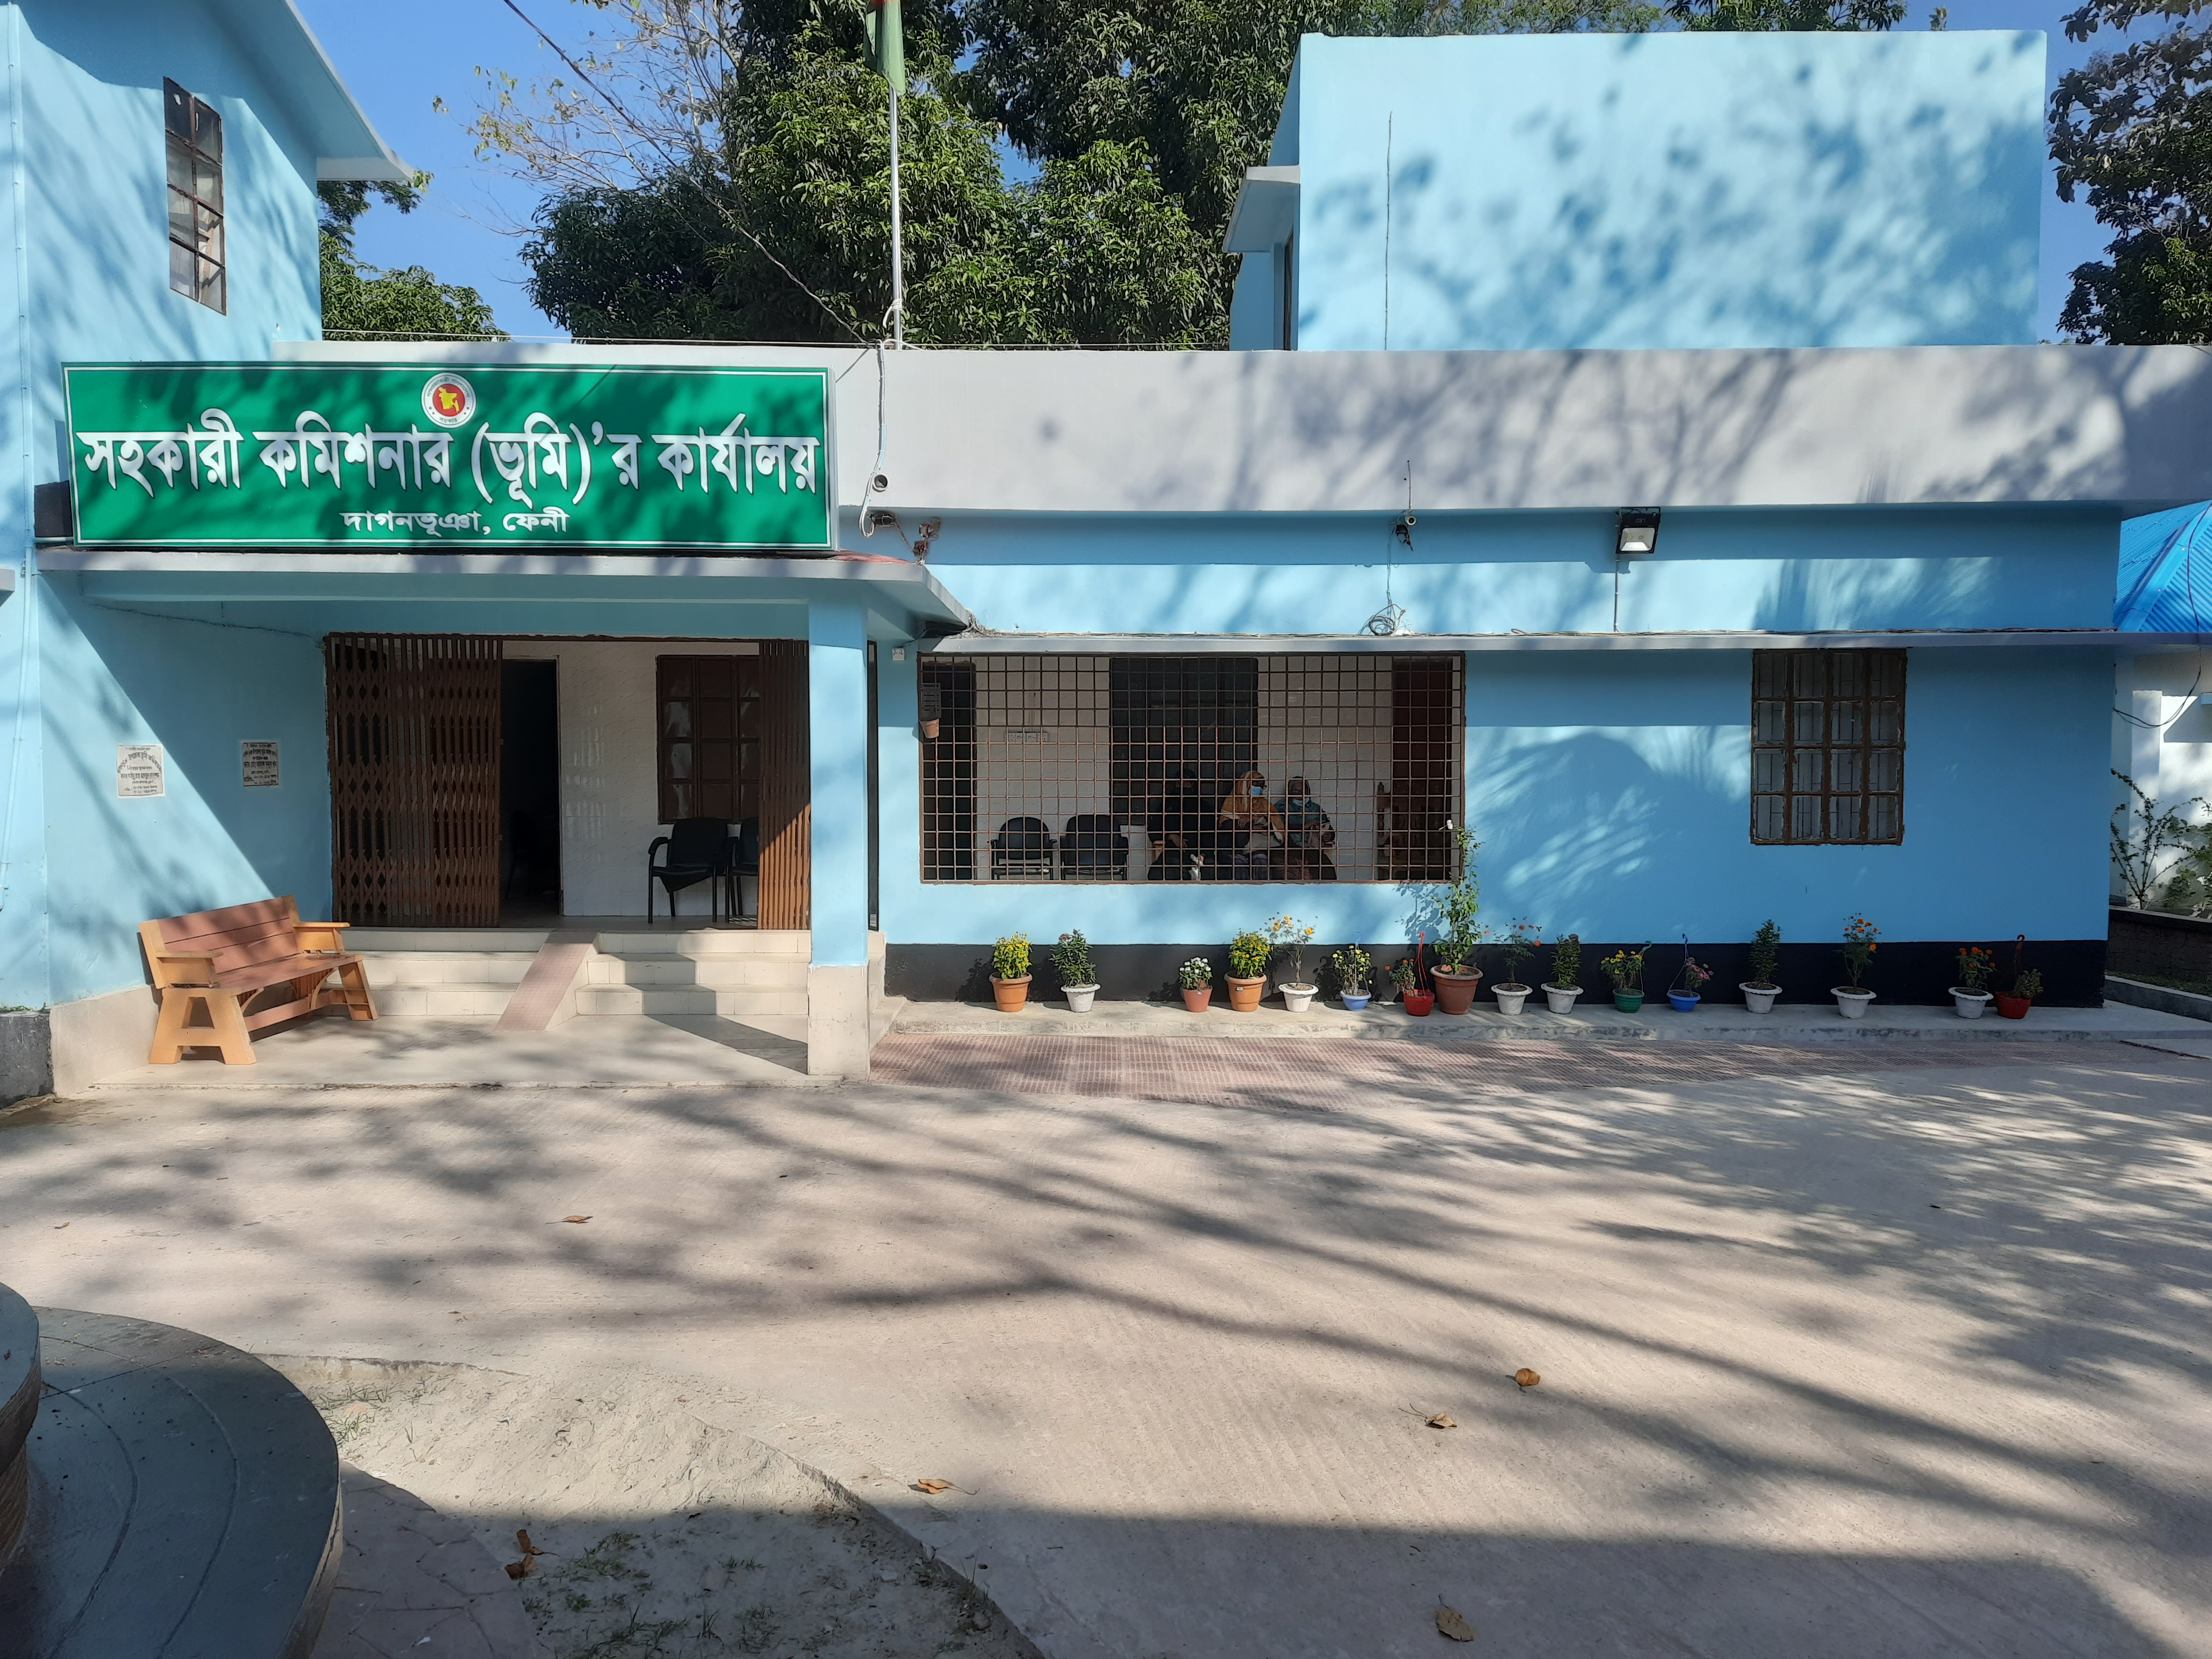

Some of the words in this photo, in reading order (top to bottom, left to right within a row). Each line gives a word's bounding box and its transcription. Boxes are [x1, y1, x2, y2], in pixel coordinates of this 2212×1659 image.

[76, 408, 244, 498] সহকারী
[252, 410, 454, 490] কমিশনার
[651, 413, 821, 494] কার্যালয়
[502, 506, 571, 533] ফেনী
